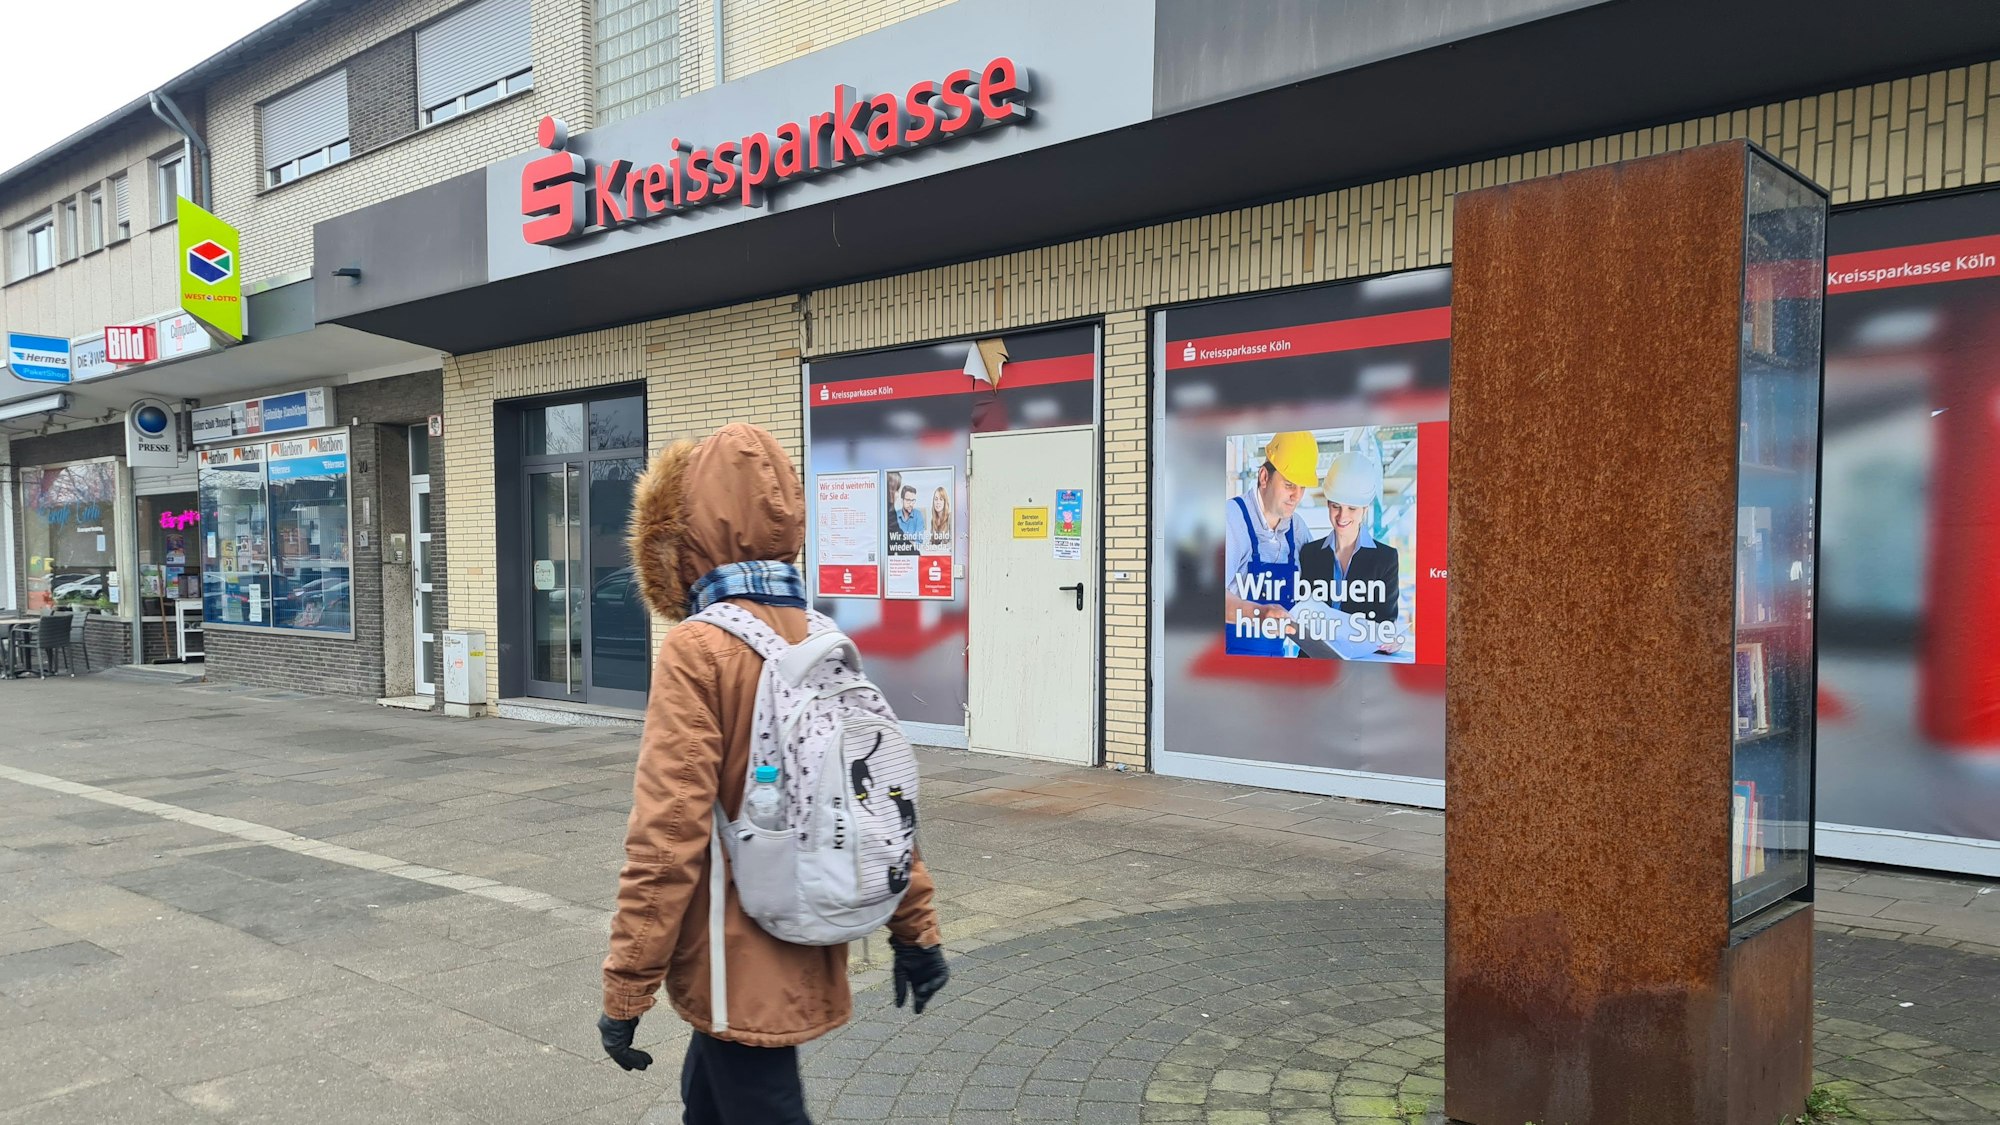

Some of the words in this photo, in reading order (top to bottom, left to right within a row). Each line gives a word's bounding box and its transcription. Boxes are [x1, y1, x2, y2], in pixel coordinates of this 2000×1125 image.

[595, 56, 1020, 227] Kreissparkasse
[1827, 262, 1951, 286] Kreissparkasse
[1956, 253, 1996, 271] Köln
[184, 293, 206, 301] WEST
[107, 328, 145, 361] Bild
[1200, 344, 1267, 360] Kreissparkasse
[1269, 340, 1291, 352] Köln
[26, 352, 67, 365] Hermes
[77, 354, 88, 369] DIE
[23, 367, 67, 379] PaketShop
[831, 388, 877, 399] Kreissparkasse
[878, 386, 893, 395] Köln
[138, 443, 172, 453] PRESSE
[279, 442, 303, 457] Marlboro
[318, 437, 344, 453] Marlboro
[241, 447, 263, 461] Marlboro
[819, 483, 830, 491] Wir
[832, 482, 845, 490] sind
[846, 481, 875, 490] weiterhin
[819, 493, 828, 501] für
[830, 492, 839, 500] Sie
[889, 531, 902, 541] Wir
[903, 531, 917, 541] sind
[934, 531, 950, 540] bald
[889, 543, 912, 552] wieder
[1236, 571, 1286, 601] Wir
[1293, 571, 1386, 603] bauen
[1236, 608, 1291, 639] hier
[1297, 609, 1342, 641] für
[1349, 611, 1405, 644] Sie.
